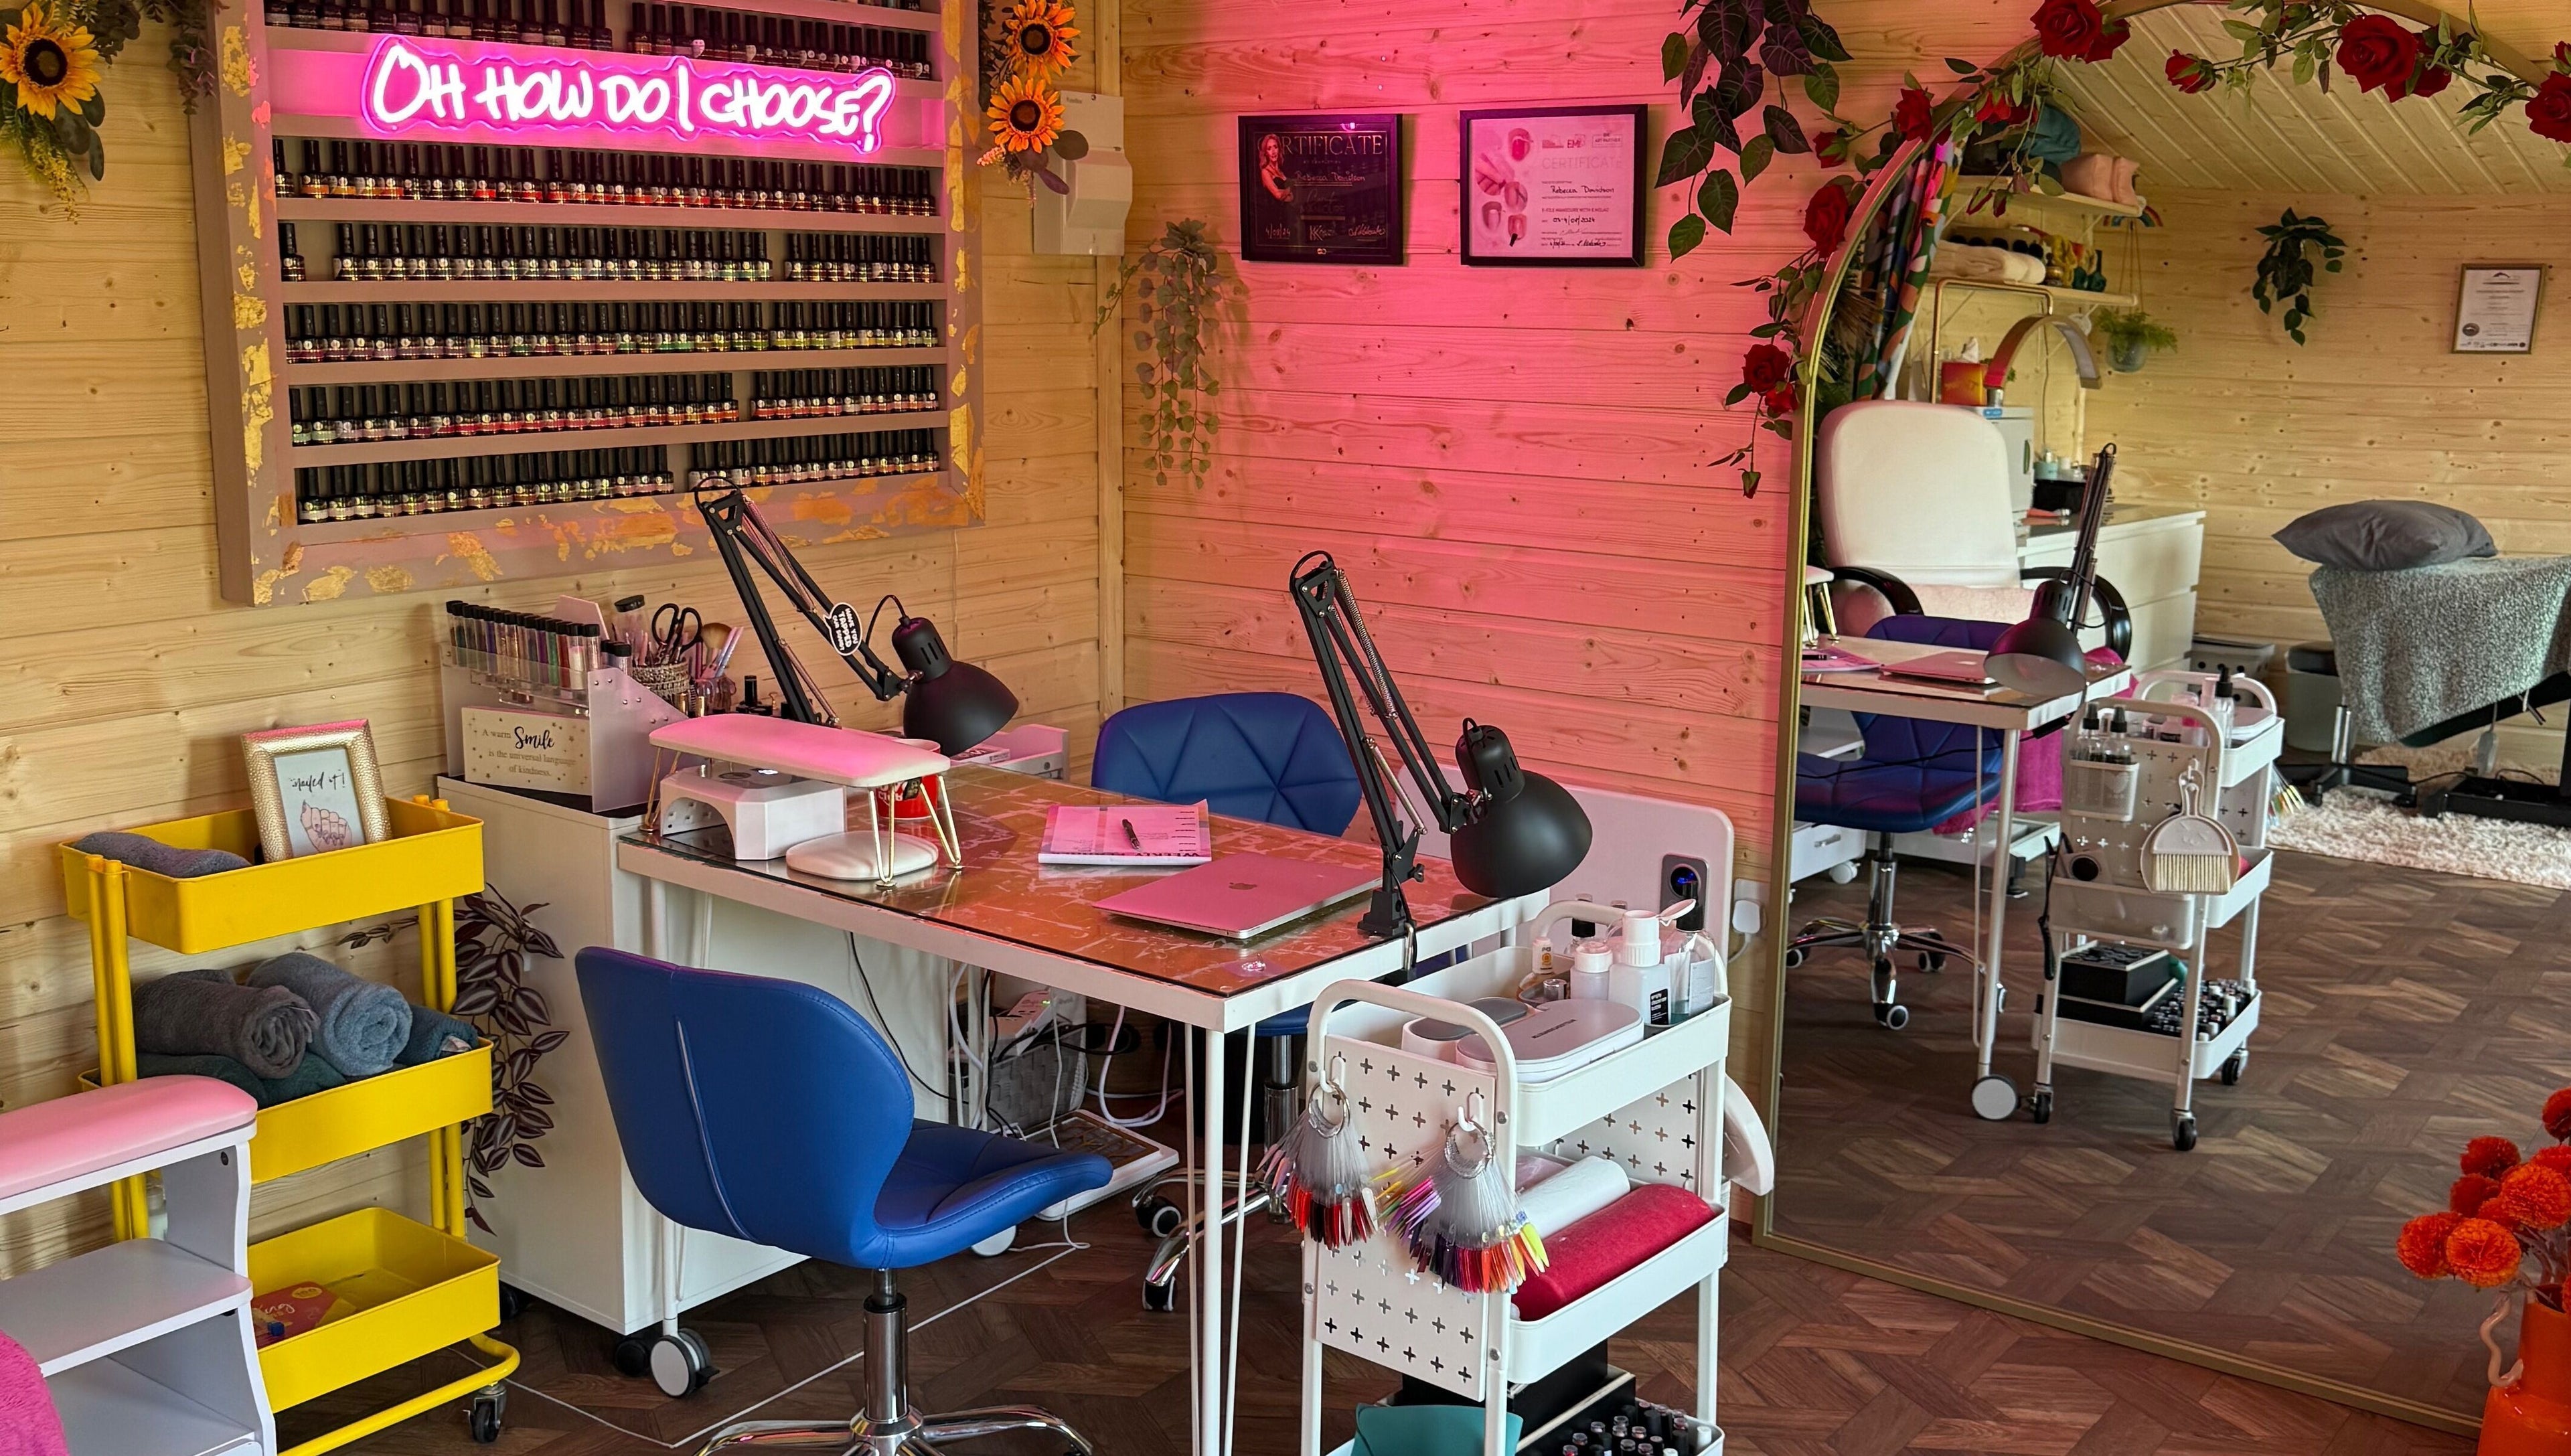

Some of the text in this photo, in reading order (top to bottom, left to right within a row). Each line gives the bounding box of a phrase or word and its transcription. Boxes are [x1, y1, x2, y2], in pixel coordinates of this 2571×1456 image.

[370, 44, 892, 153] OH HOW DO I CHOOSE?
[1257, 135, 1383, 155] RTIFICATE
[1542, 157, 1623, 169] CERTIFICATE
[491, 730, 512, 738] warm
[514, 726, 554, 750] Smile
[497, 750, 508, 758] the
[509, 752, 542, 762] universal
[543, 755, 576, 766] language
[509, 764, 516, 773] of
